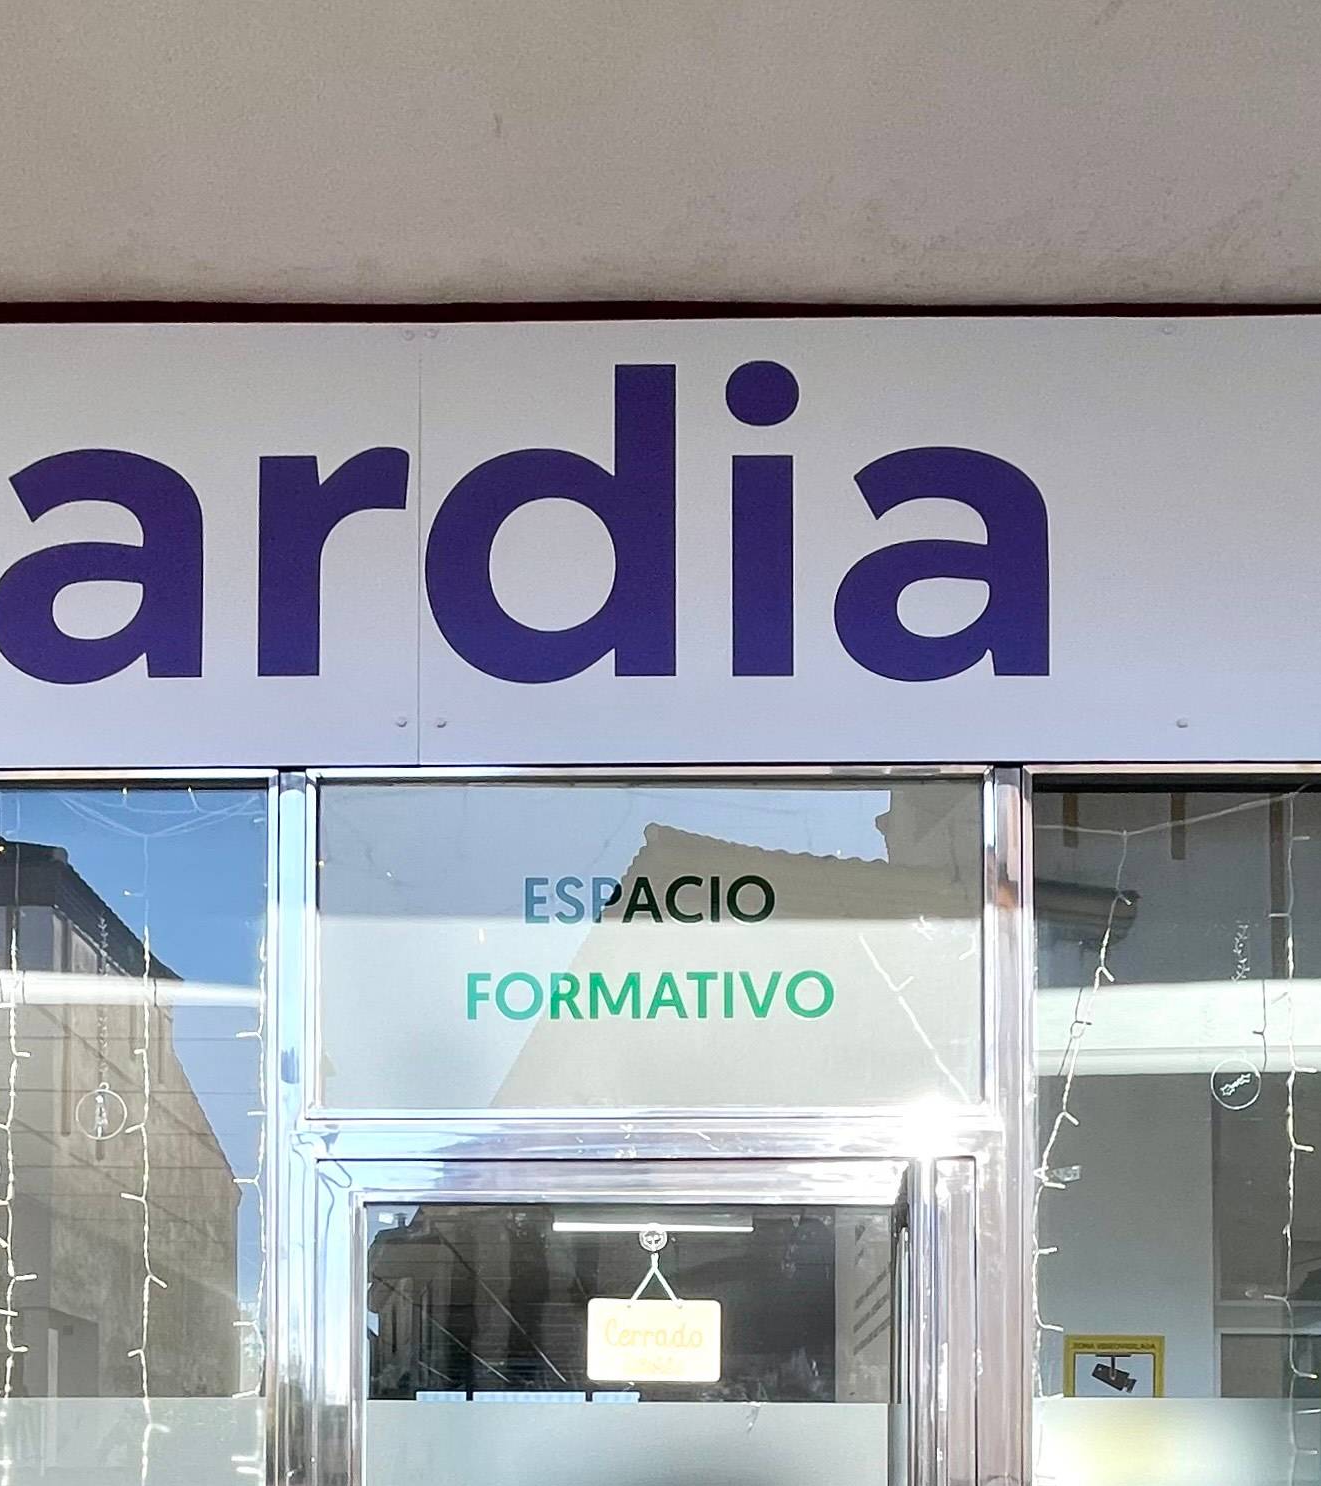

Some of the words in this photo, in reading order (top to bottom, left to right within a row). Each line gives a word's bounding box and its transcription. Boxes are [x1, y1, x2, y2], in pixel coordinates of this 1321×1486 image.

[523, 875, 776, 924] ESPACIO
[465, 970, 835, 1020] FORMATIVO
[604, 1317, 704, 1348] Cerrado
